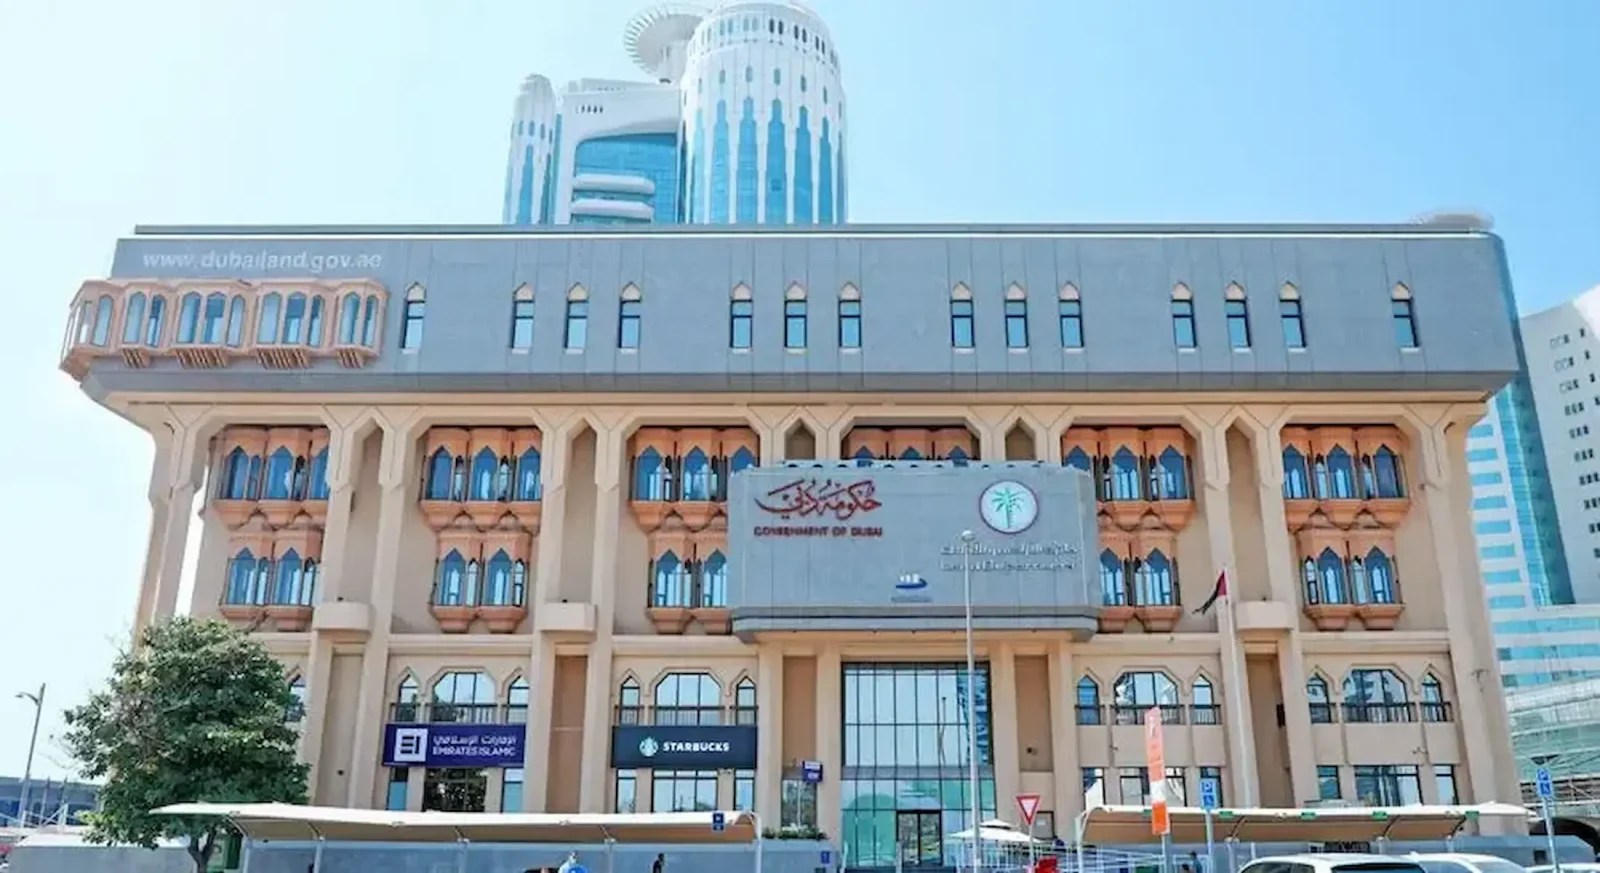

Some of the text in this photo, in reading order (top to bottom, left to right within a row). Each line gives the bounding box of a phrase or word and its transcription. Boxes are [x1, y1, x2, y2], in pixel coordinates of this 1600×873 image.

[143, 250, 383, 273] www.dubailand.gov.ae
[754, 525, 883, 537] GOVERNMENT OF DUBAI
[432, 745, 516, 757] EMIRATES ISLAMIC
[662, 741, 730, 752] STARBUCKS
